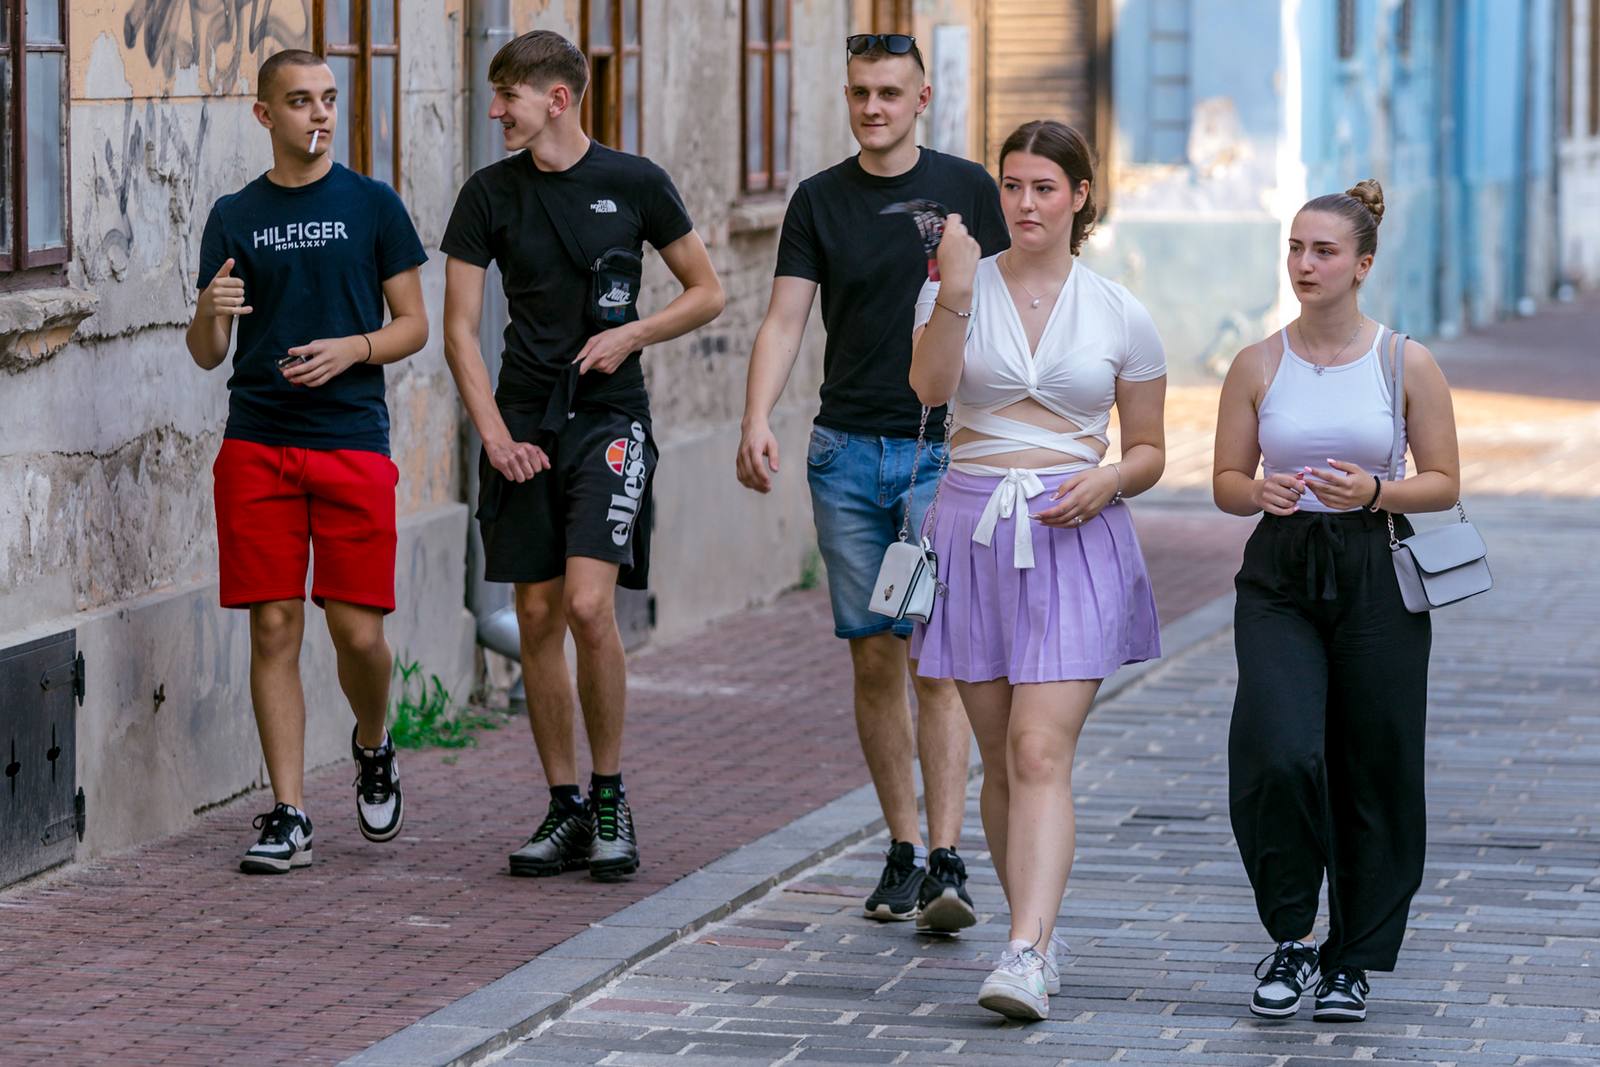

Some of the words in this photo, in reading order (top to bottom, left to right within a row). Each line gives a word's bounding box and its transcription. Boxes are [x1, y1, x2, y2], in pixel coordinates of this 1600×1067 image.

[253, 221, 349, 248] HILFIGER
[275, 240, 327, 251] MCMLXXXV
[607, 287, 631, 302] NIKE
[606, 420, 646, 546] ellesse
